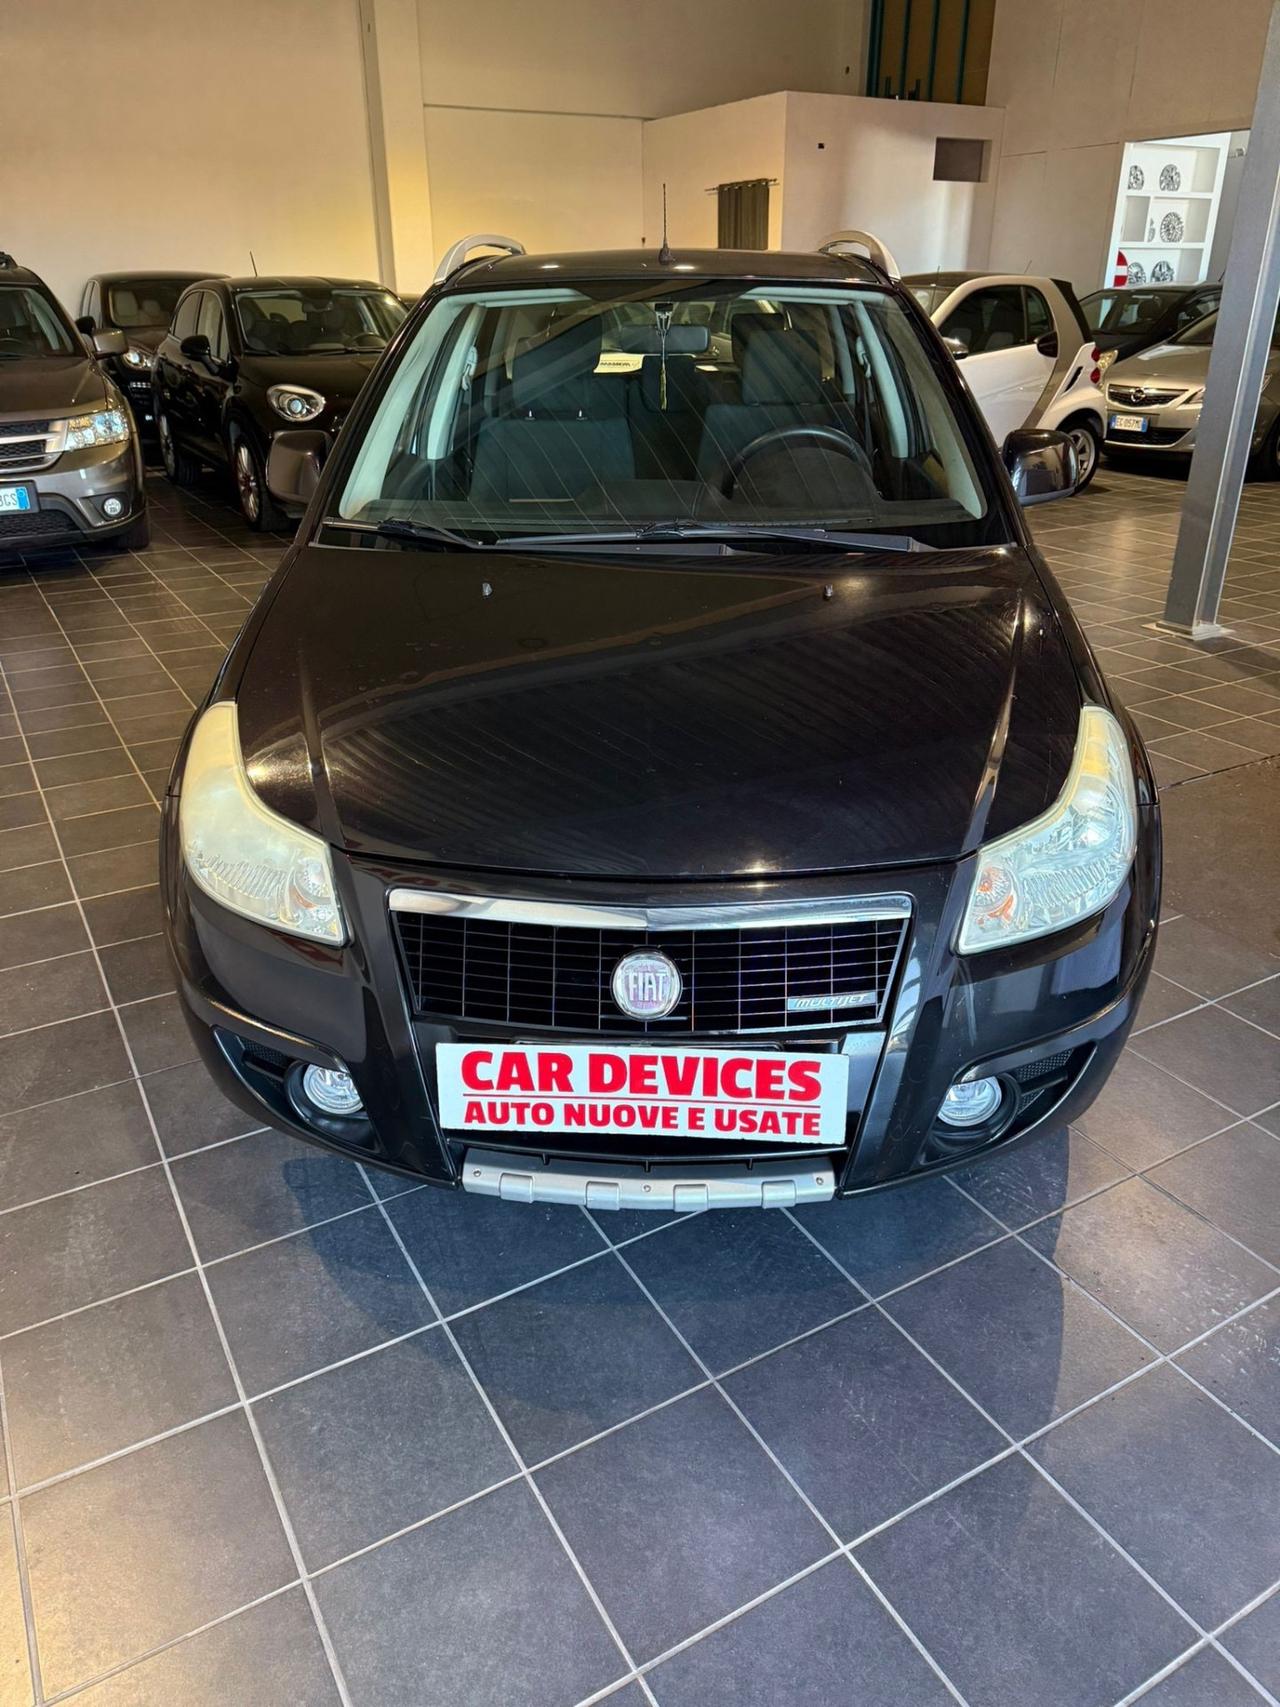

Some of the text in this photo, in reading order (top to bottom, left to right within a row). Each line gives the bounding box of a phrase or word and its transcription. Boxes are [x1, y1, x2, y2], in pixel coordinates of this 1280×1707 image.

[628, 972, 668, 1001] FIAT
[461, 1050, 821, 1102] CAR DEVICES
[464, 1101, 821, 1136] AUTO NUOVE E USATE
